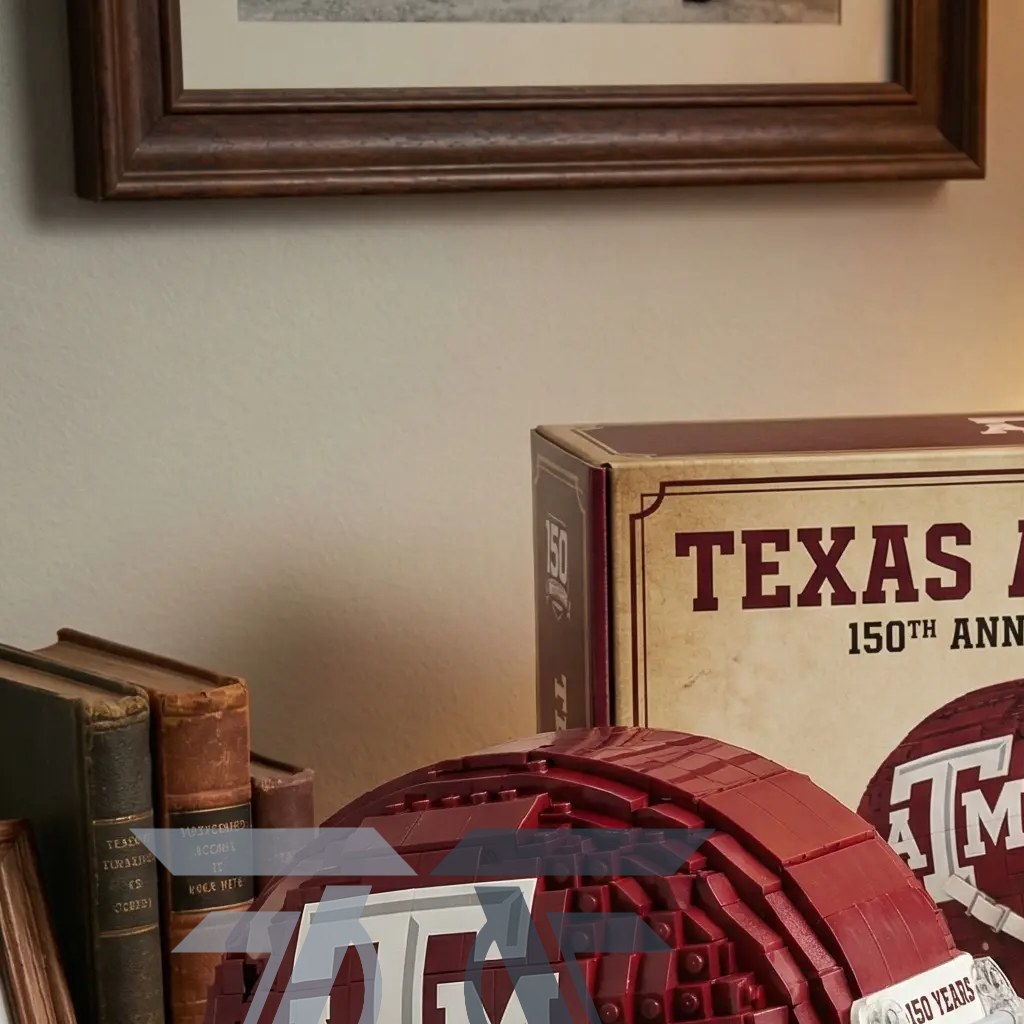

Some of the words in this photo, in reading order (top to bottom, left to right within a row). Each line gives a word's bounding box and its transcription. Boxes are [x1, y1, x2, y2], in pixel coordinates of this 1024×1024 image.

[545, 519, 568, 585] 150
[674, 522, 972, 612] TEXAS
[848, 619, 937, 655] 150TH
[931, 976, 976, 1016] YEARS
